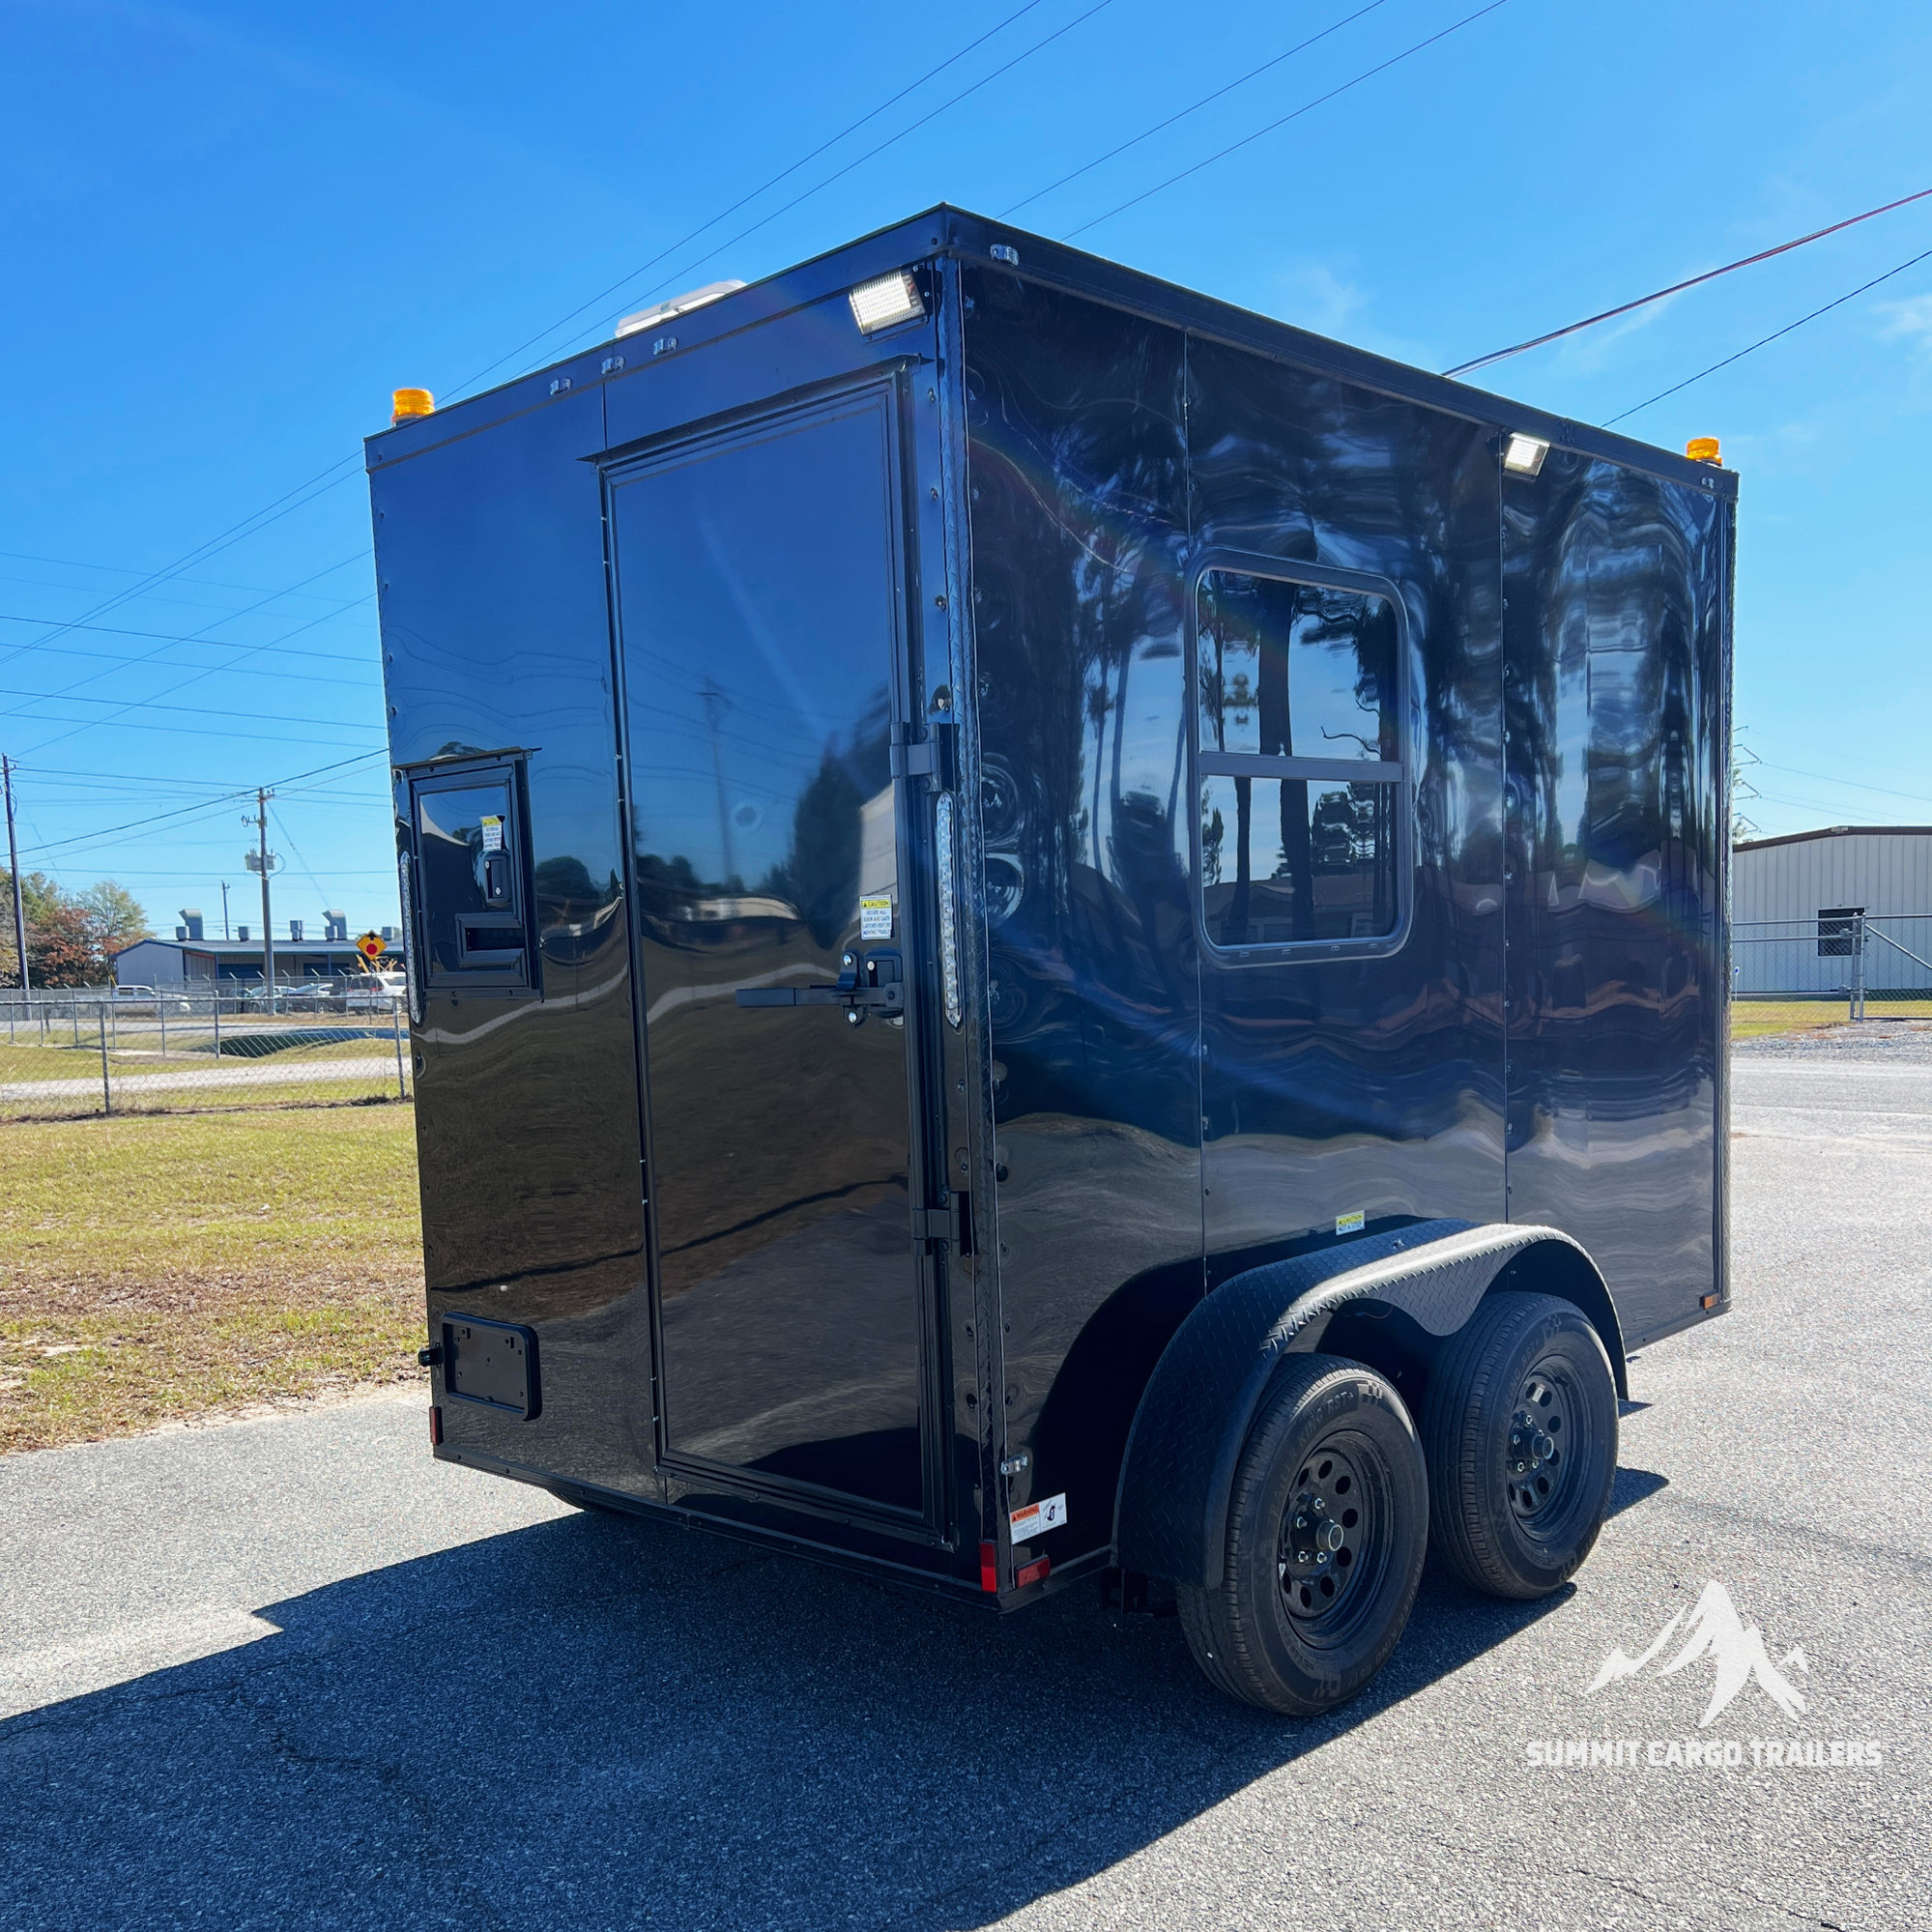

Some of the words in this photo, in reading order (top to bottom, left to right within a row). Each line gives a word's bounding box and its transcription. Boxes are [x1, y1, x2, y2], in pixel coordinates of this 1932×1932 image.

[1341, 1214, 1363, 1224] CAUTION
[1504, 1369, 1521, 1408] KING
[1298, 1408, 1324, 1447] KING
[1017, 1505, 1039, 1518] WARNING
